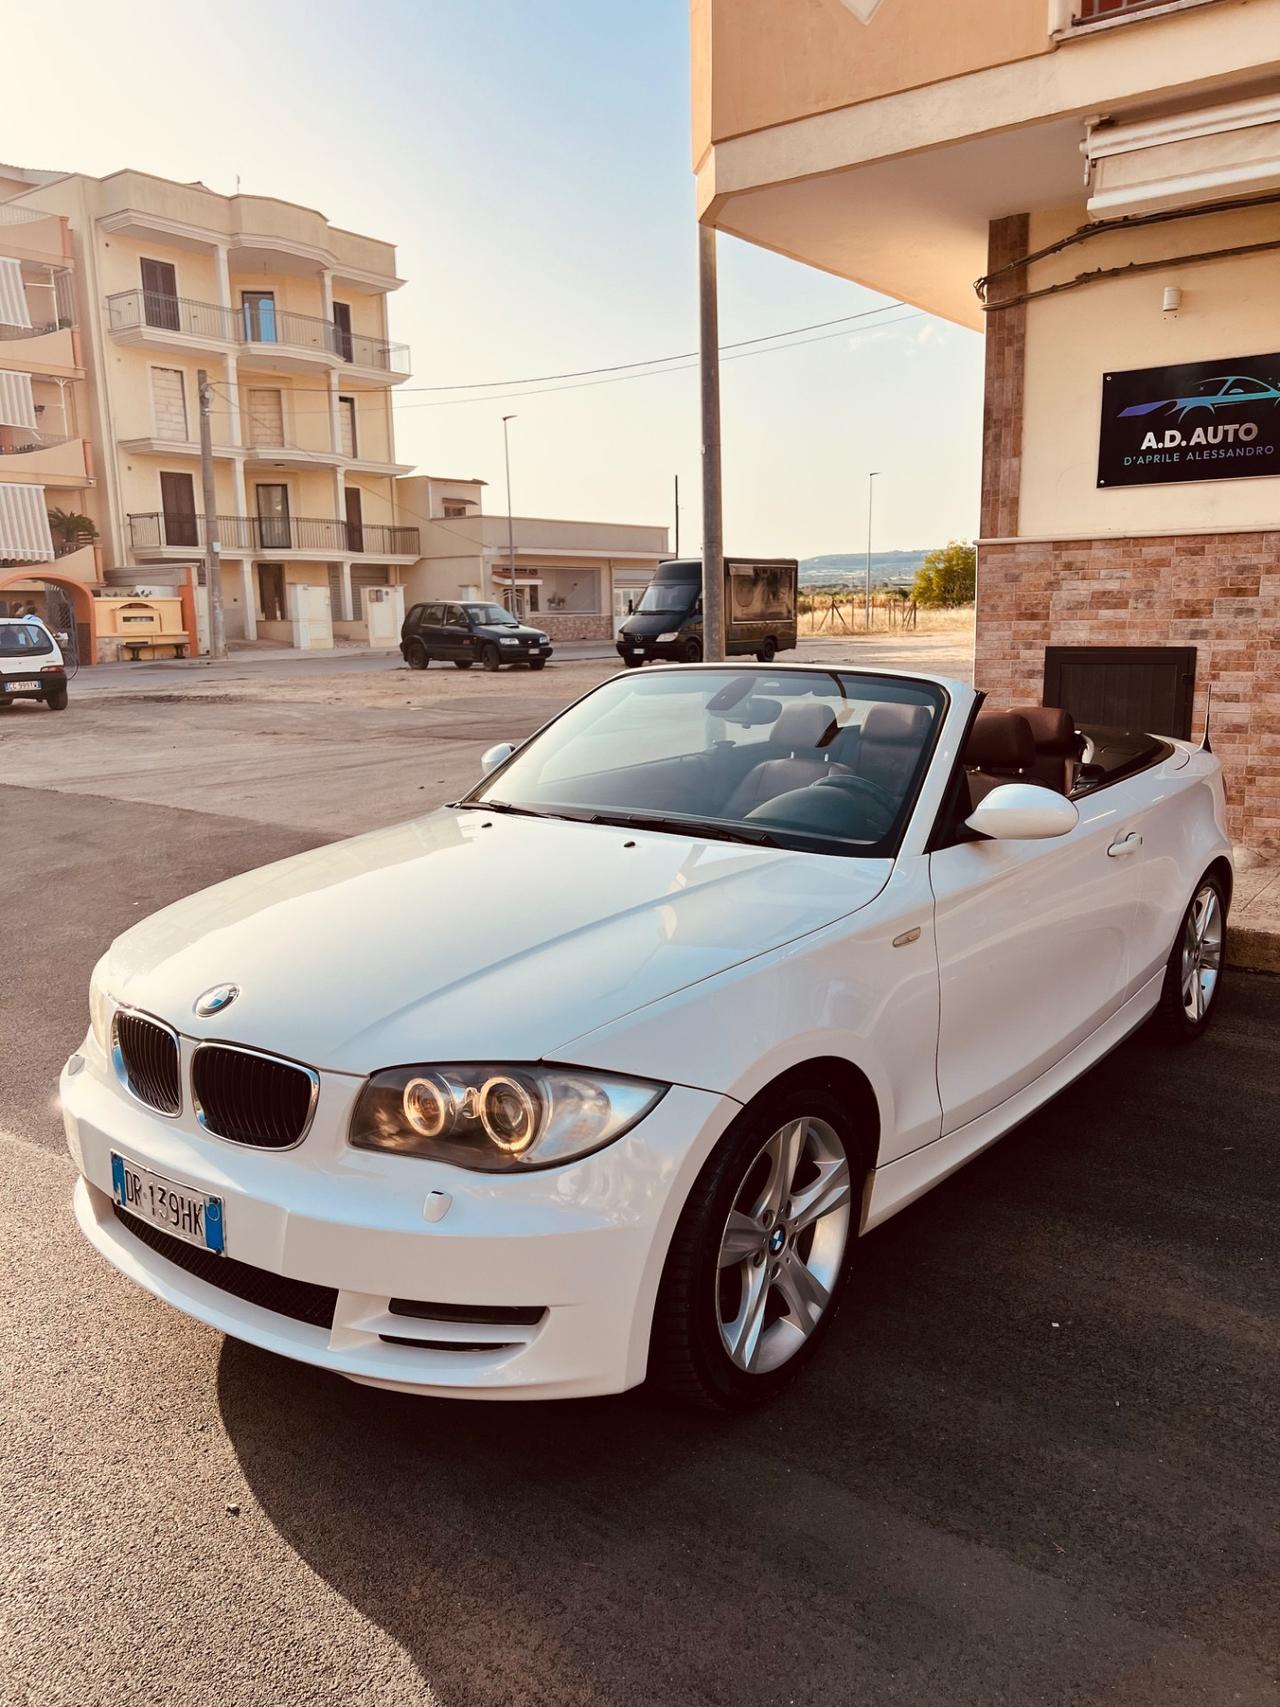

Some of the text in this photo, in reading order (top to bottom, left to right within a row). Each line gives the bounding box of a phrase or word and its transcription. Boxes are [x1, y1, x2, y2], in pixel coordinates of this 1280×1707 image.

[1140, 422, 1259, 450] A.D. AUTO
[1123, 445, 1275, 466] D'APRILE ALESSANDRO
